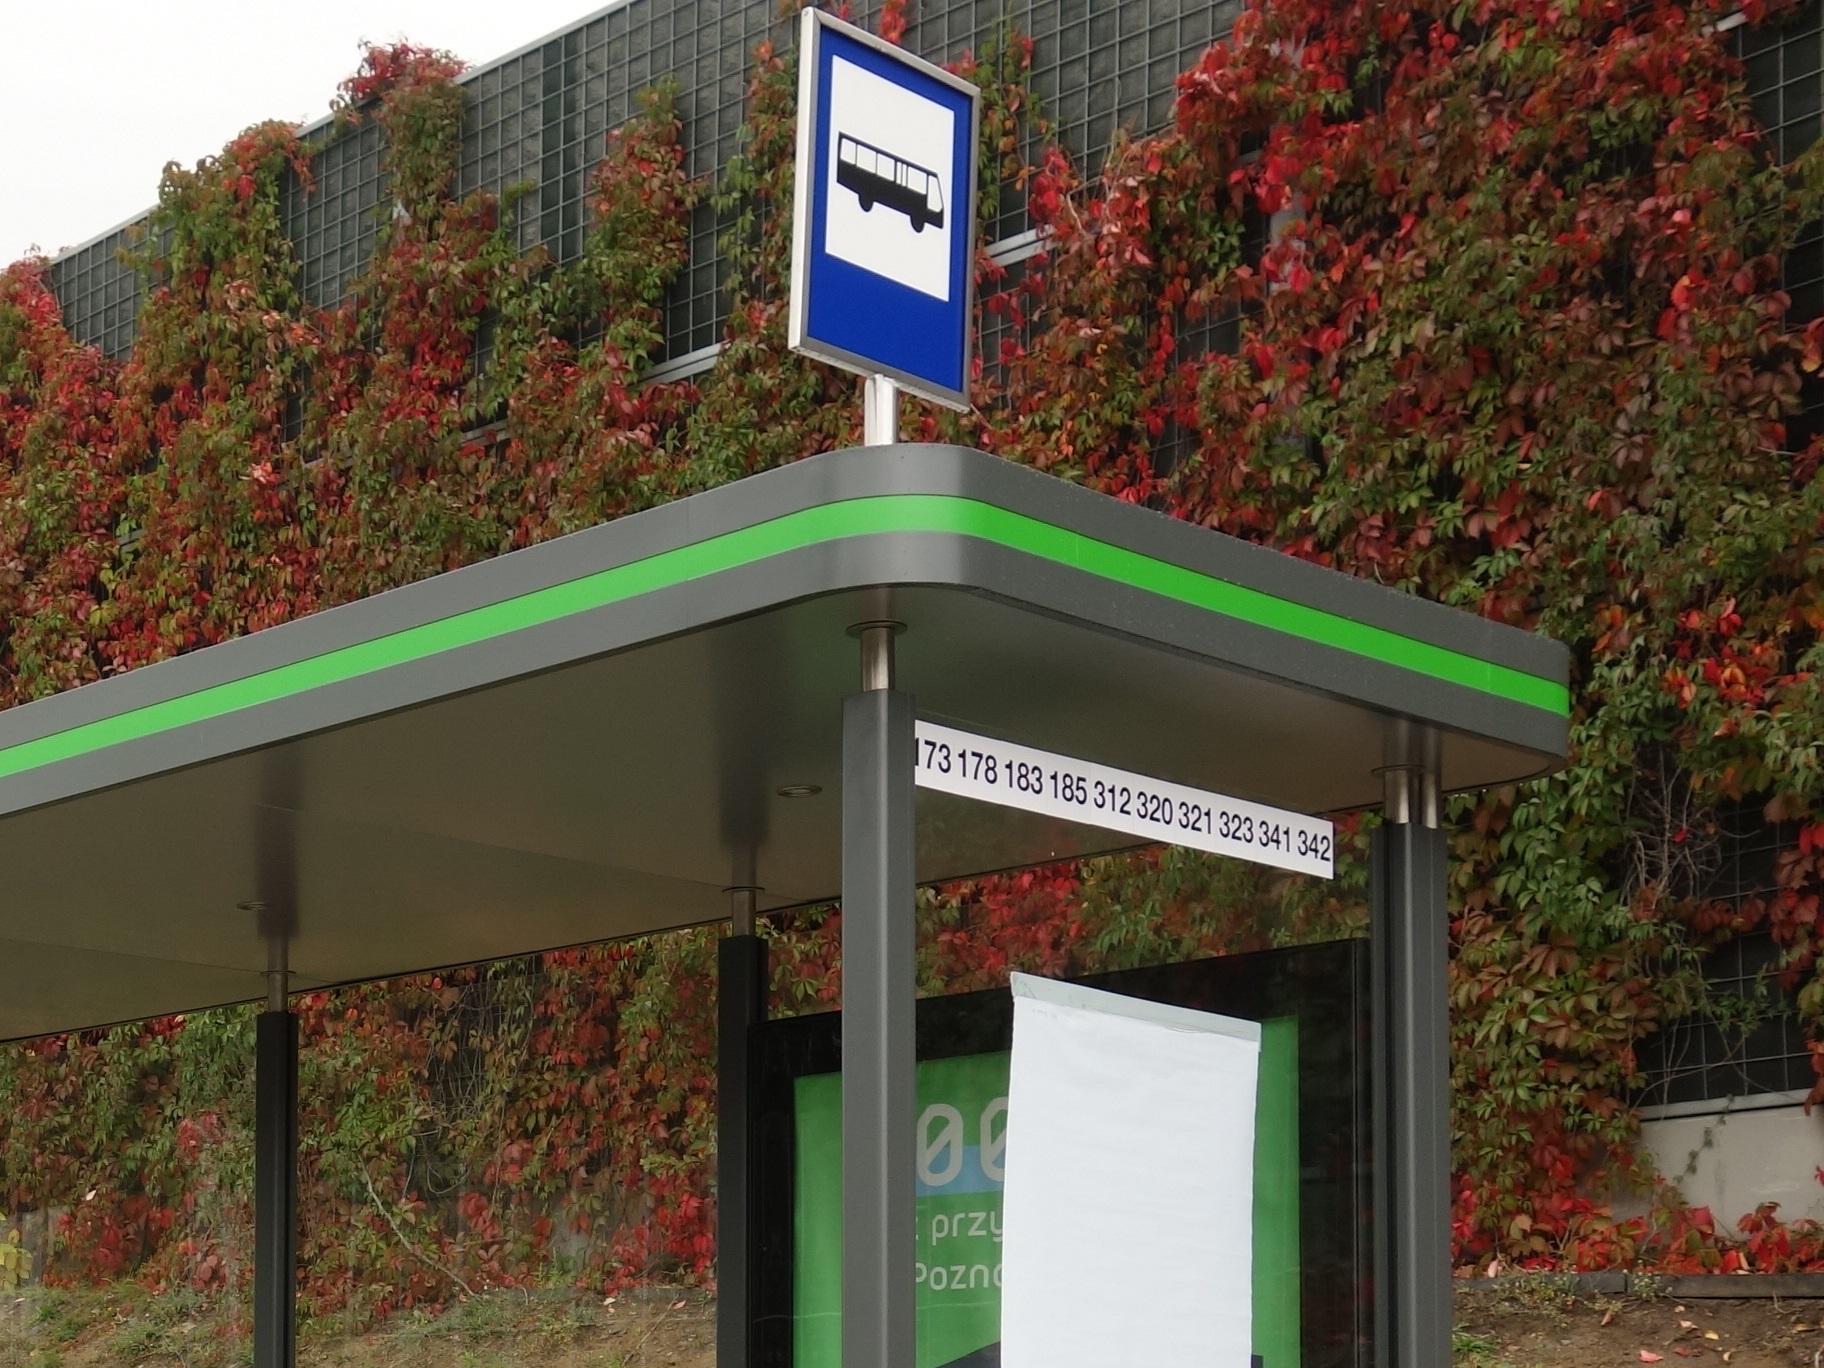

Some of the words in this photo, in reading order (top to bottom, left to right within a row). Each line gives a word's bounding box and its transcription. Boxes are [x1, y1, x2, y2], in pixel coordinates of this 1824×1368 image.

[958, 749, 998, 784] 178
[1005, 760, 1043, 795] 183
[1050, 771, 1087, 804] 185
[1093, 781, 1132, 814] 312
[1136, 791, 1173, 825] 320
[1178, 802, 1212, 834] 321
[1219, 811, 1254, 843] 323
[1259, 821, 1291, 852] 341
[1297, 830, 1331, 861] 342
[916, 1096, 1008, 1186] 00
[931, 1211, 1003, 1246] przy
